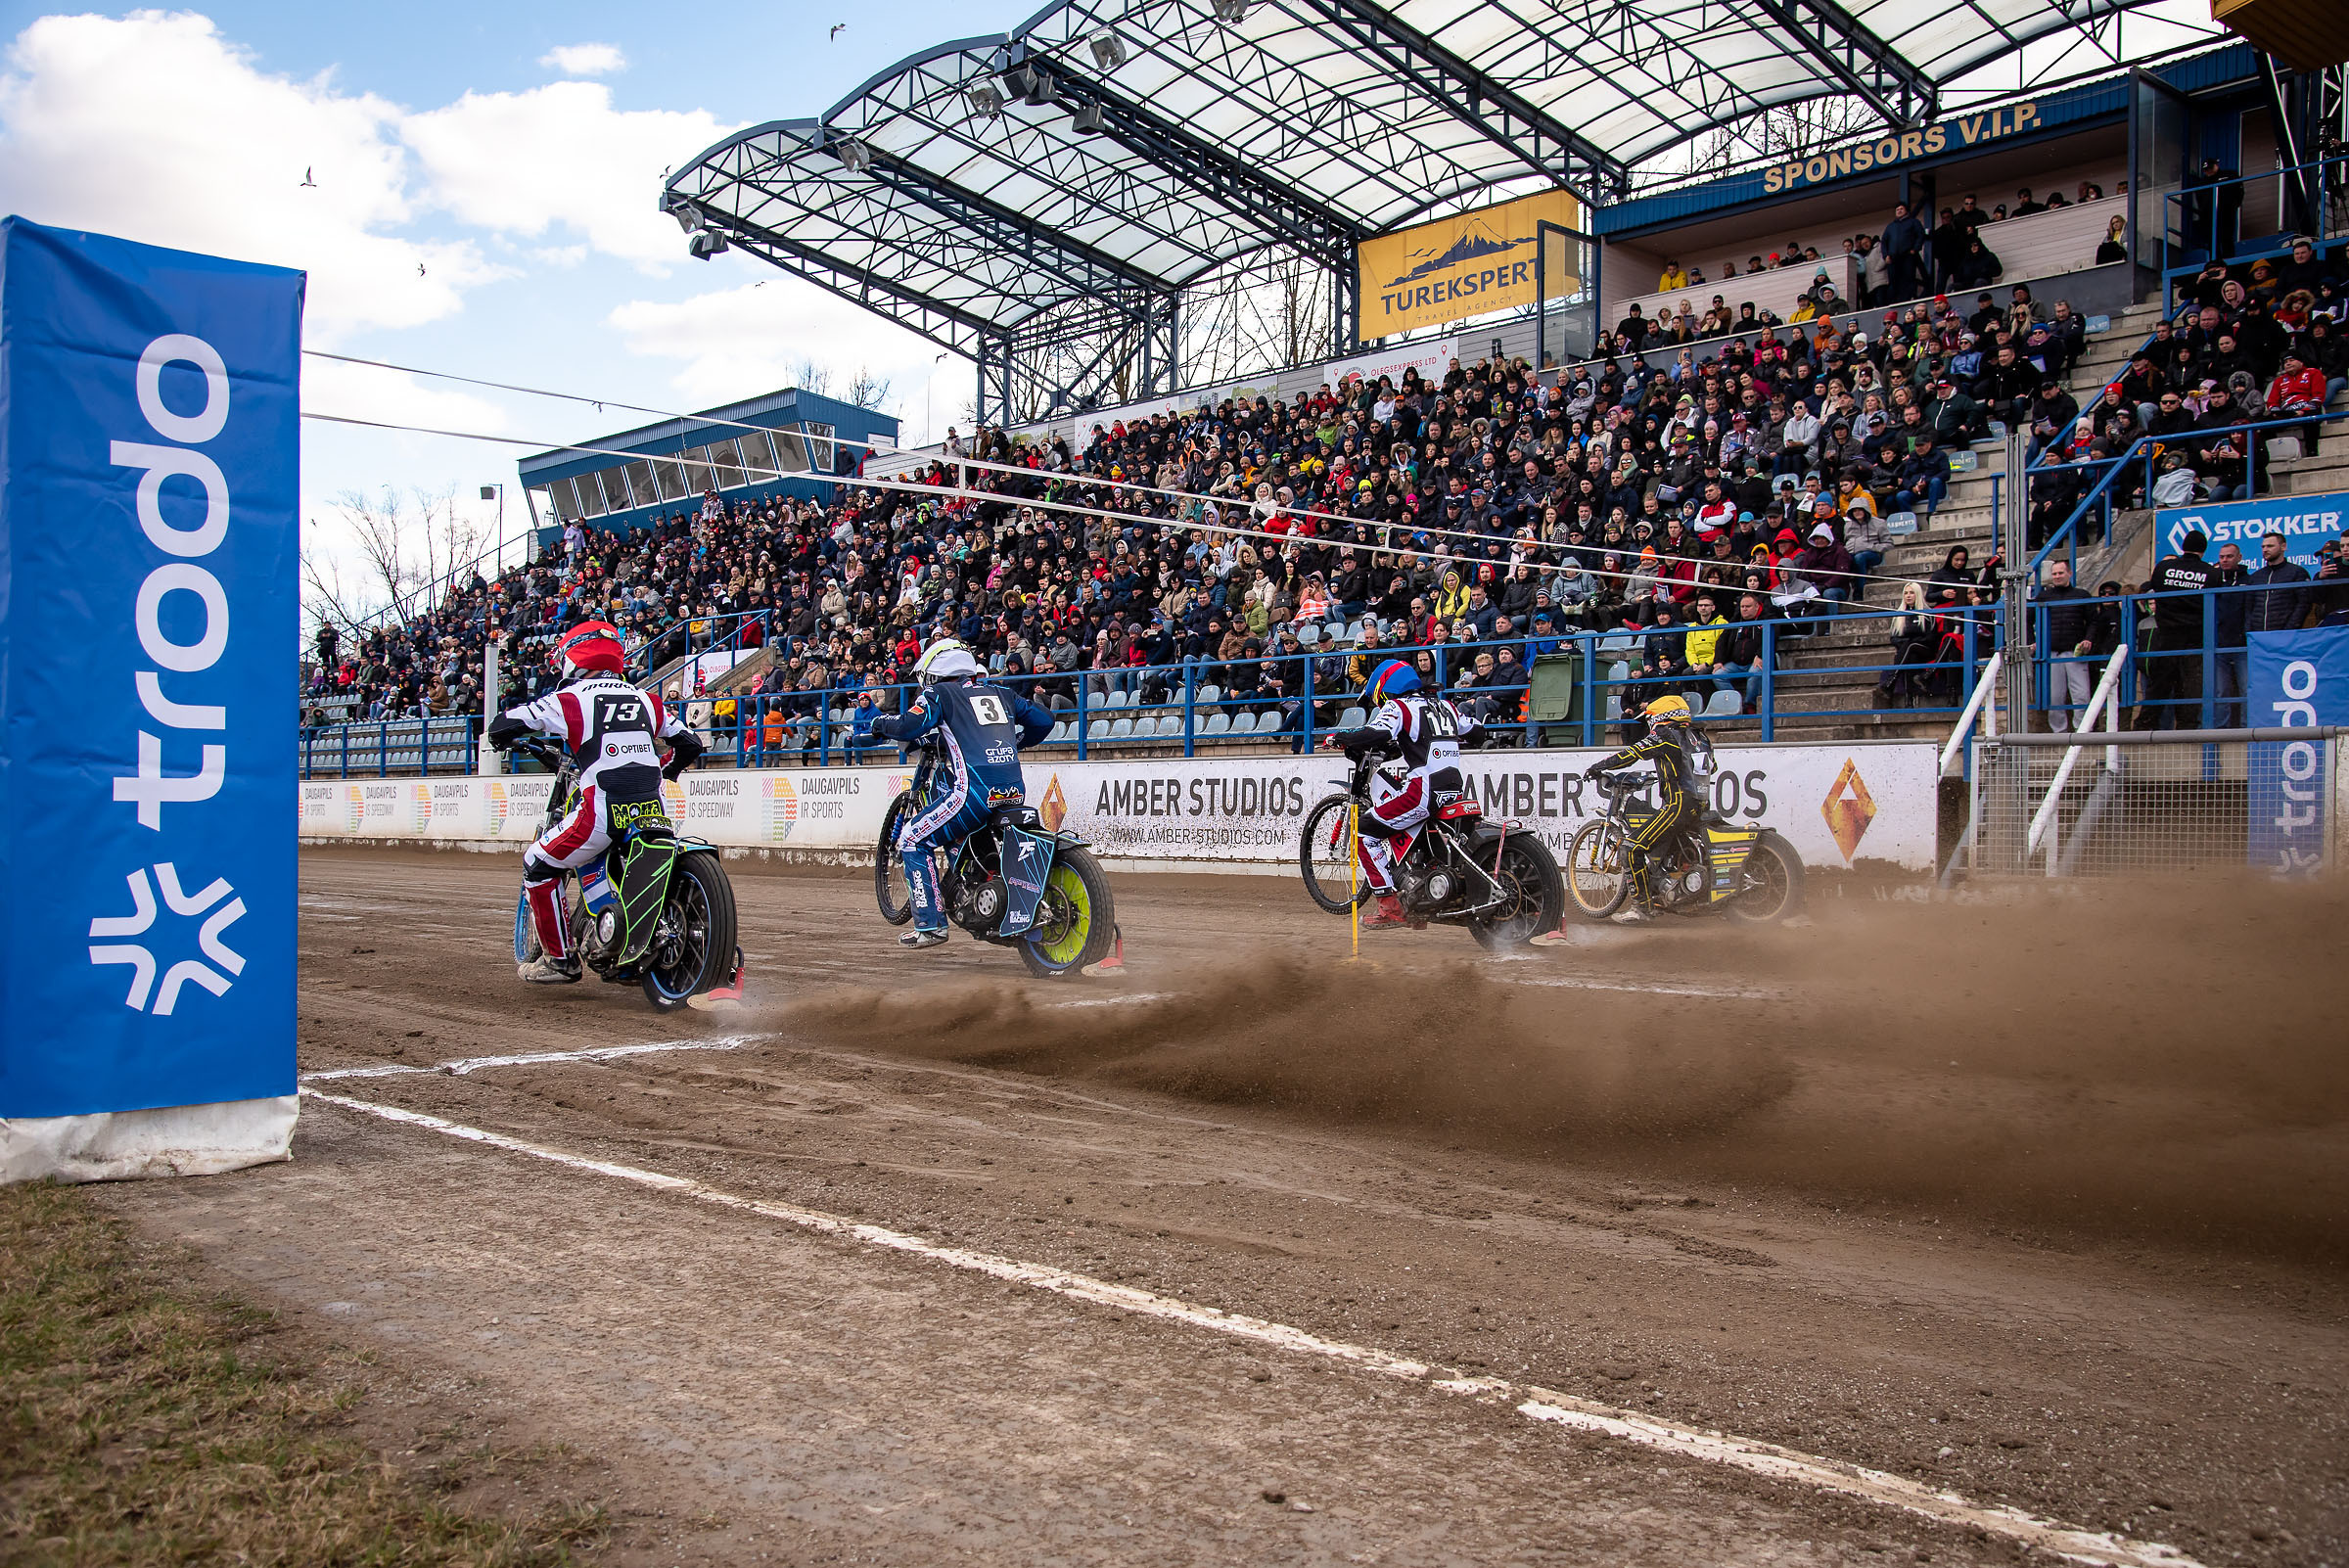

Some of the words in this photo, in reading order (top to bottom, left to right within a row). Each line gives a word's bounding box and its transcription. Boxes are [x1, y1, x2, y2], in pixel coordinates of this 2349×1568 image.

[1763, 126, 1947, 193] SPONSORS
[1958, 103, 2042, 144] V.I.P.
[1417, 309, 1457, 322] TRAVEL
[1467, 296, 1512, 310] AGENCY
[1425, 357, 1437, 366] LTD
[2213, 512, 2341, 541] STOKKER
[111, 334, 230, 832] trodo
[2164, 578, 2204, 589] SECURITY
[2165, 569, 2206, 582] GROM
[603, 703, 641, 723] 13
[981, 698, 999, 721] 3
[1427, 712, 1453, 735] 14
[621, 744, 651, 754] OPTIBET
[2273, 661, 2317, 837] trodo
[304, 788, 333, 800] DAUGAVPILS
[366, 786, 397, 799] DAUGAVPILS
[434, 785, 469, 798] DAUGAVPILS
[510, 783, 548, 797] DAUGAVPILS
[689, 779, 739, 797] DAUGAVPILS
[802, 778, 859, 795] DAUGAVPILS
[1461, 772, 1584, 817] AMBER
[1095, 778, 1181, 816] AMBER
[1188, 776, 1304, 817] STUDIOS
[310, 805, 326, 815] SPORTS
[371, 804, 394, 815] SPEEDWAY
[434, 804, 438, 815] IR
[439, 804, 459, 816] SPORTS
[509, 803, 515, 816] IS
[517, 802, 546, 816] SPEEDWAY
[688, 802, 696, 817] IS
[697, 802, 735, 818] SPEEDWAY
[801, 802, 809, 818] IR
[811, 802, 844, 818] SPORTS
